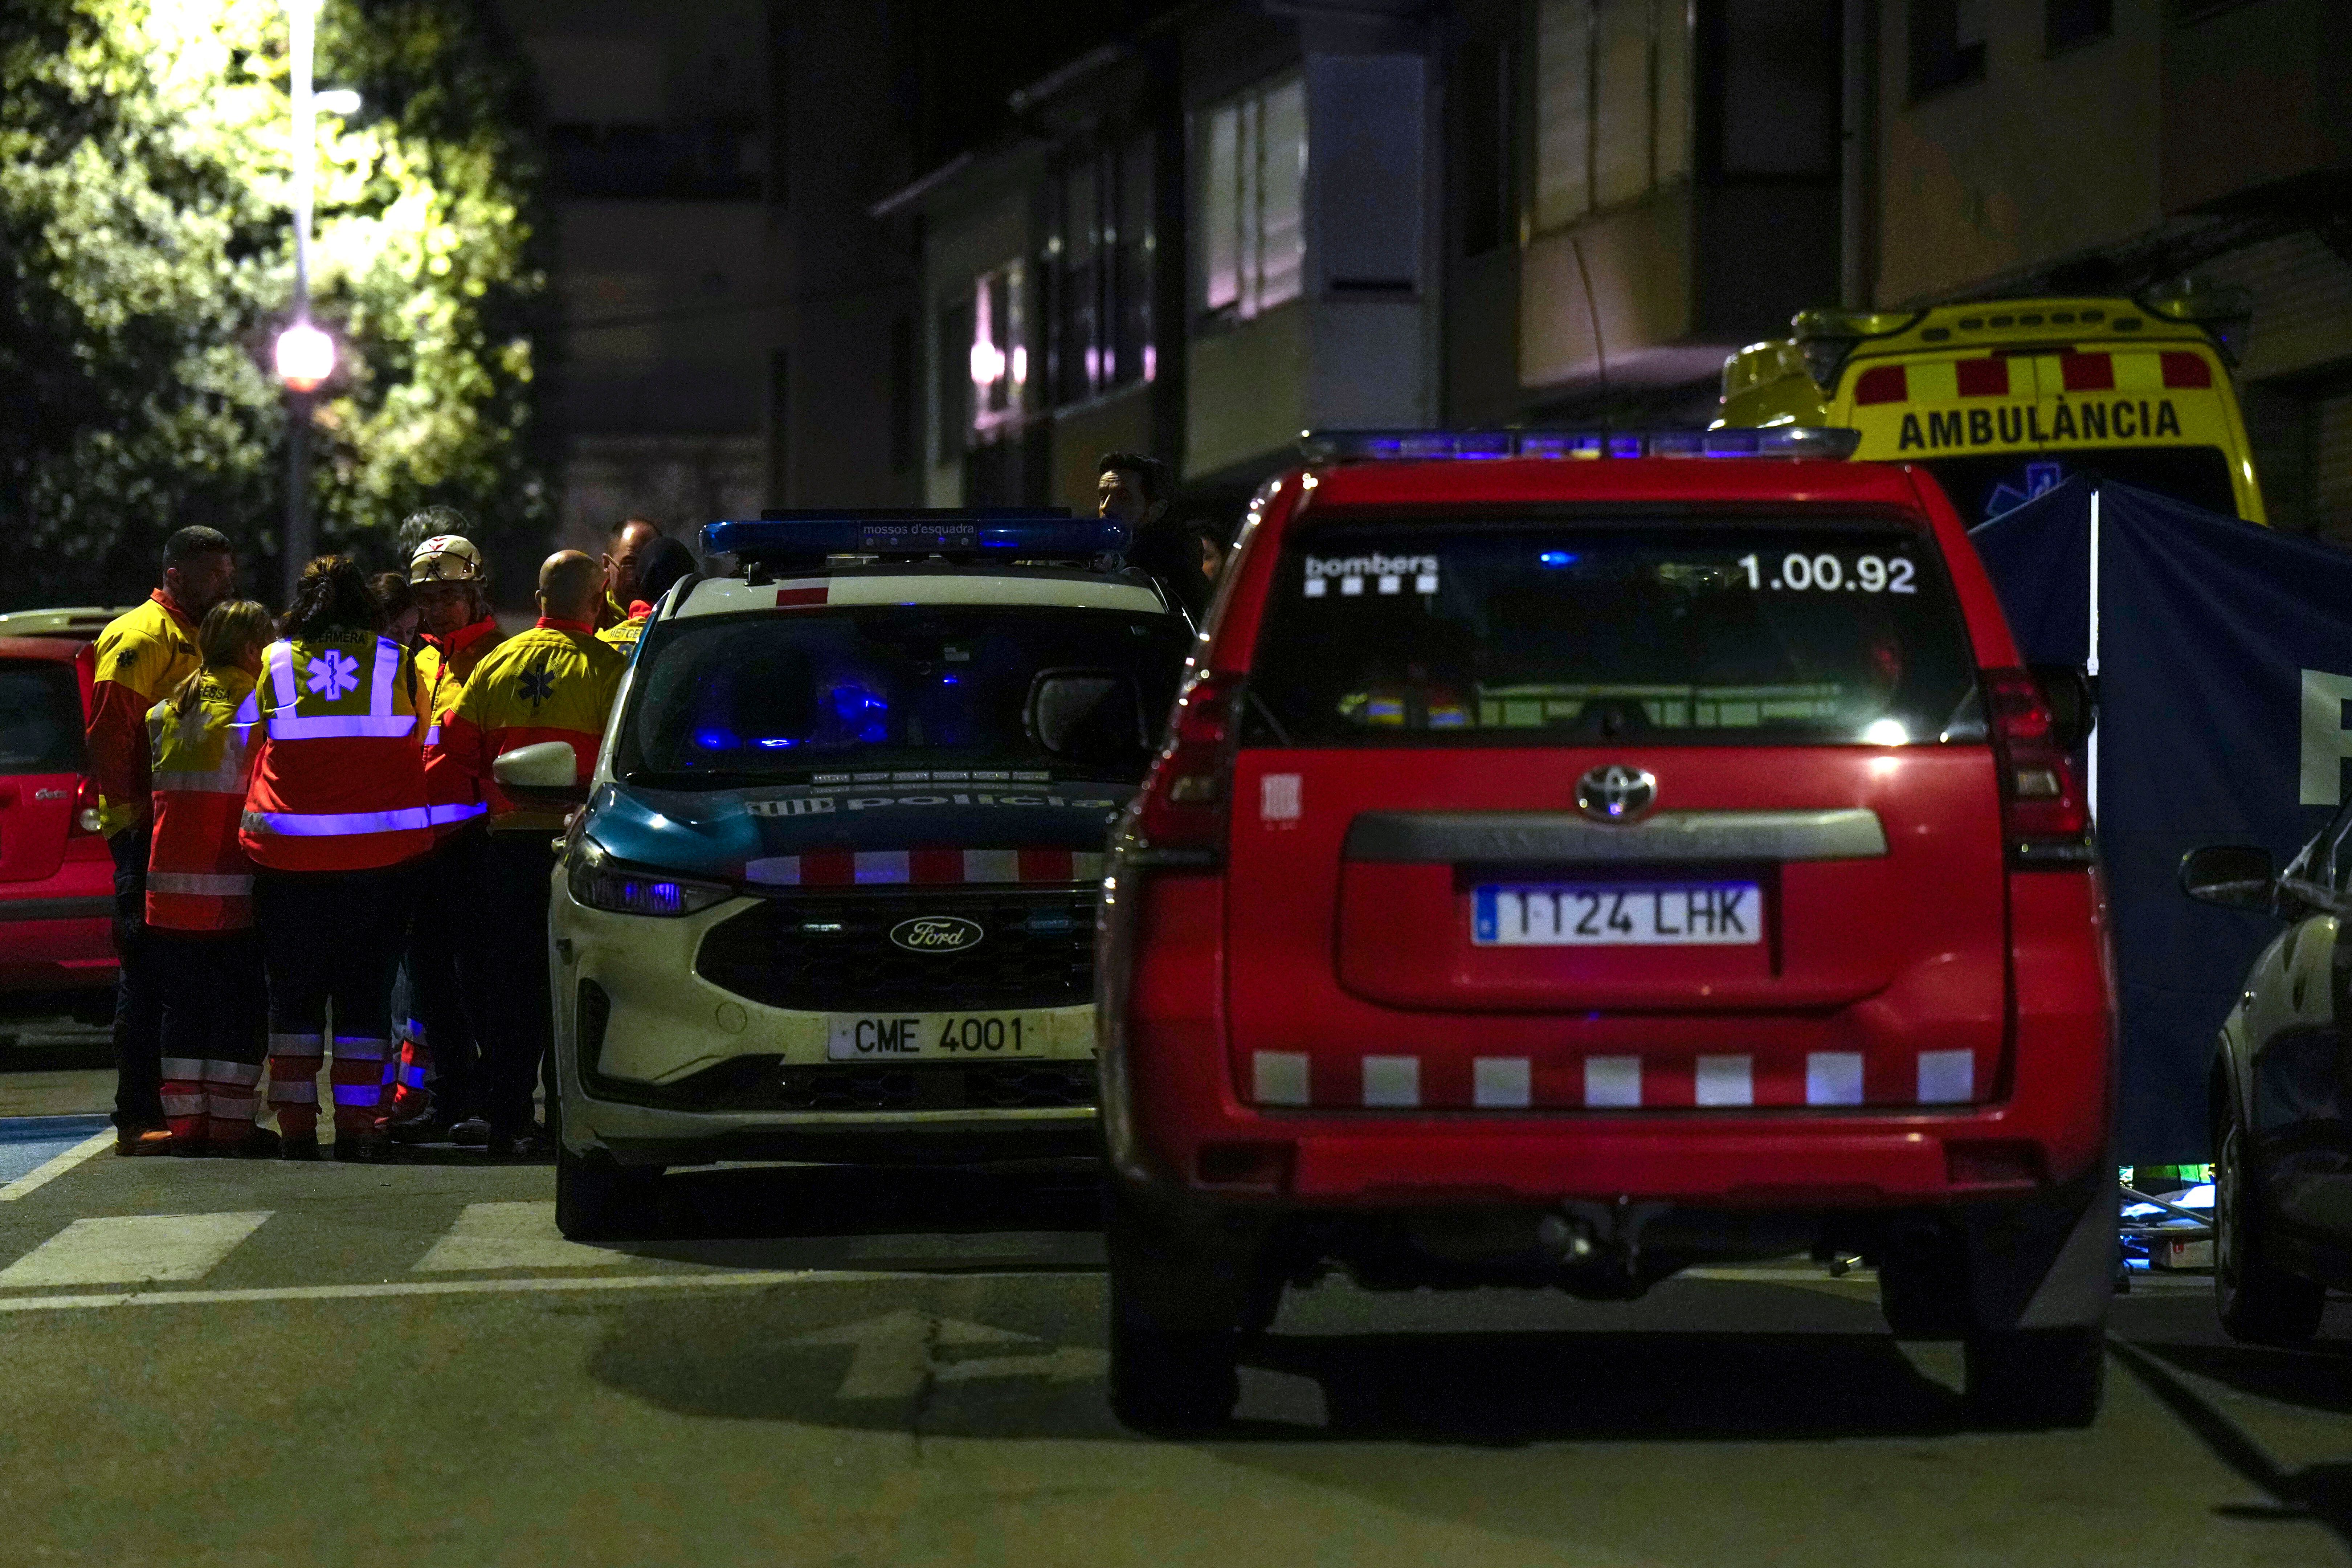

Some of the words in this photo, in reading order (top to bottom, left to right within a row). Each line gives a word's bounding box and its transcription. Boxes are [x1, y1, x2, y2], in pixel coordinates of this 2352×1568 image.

[1899, 395, 2181, 450] AMBULÀNCIA
[864, 526, 907, 534] mossos
[911, 523, 974, 536] d'esquadra
[1304, 553, 1438, 579] bombers
[1738, 552, 1918, 594] 1.00.92
[1519, 889, 1632, 935] 1124
[1654, 887, 1748, 934] LHK
[908, 922, 965, 944] Ford
[855, 1018, 919, 1052] CME
[939, 1017, 1022, 1052] 4001
